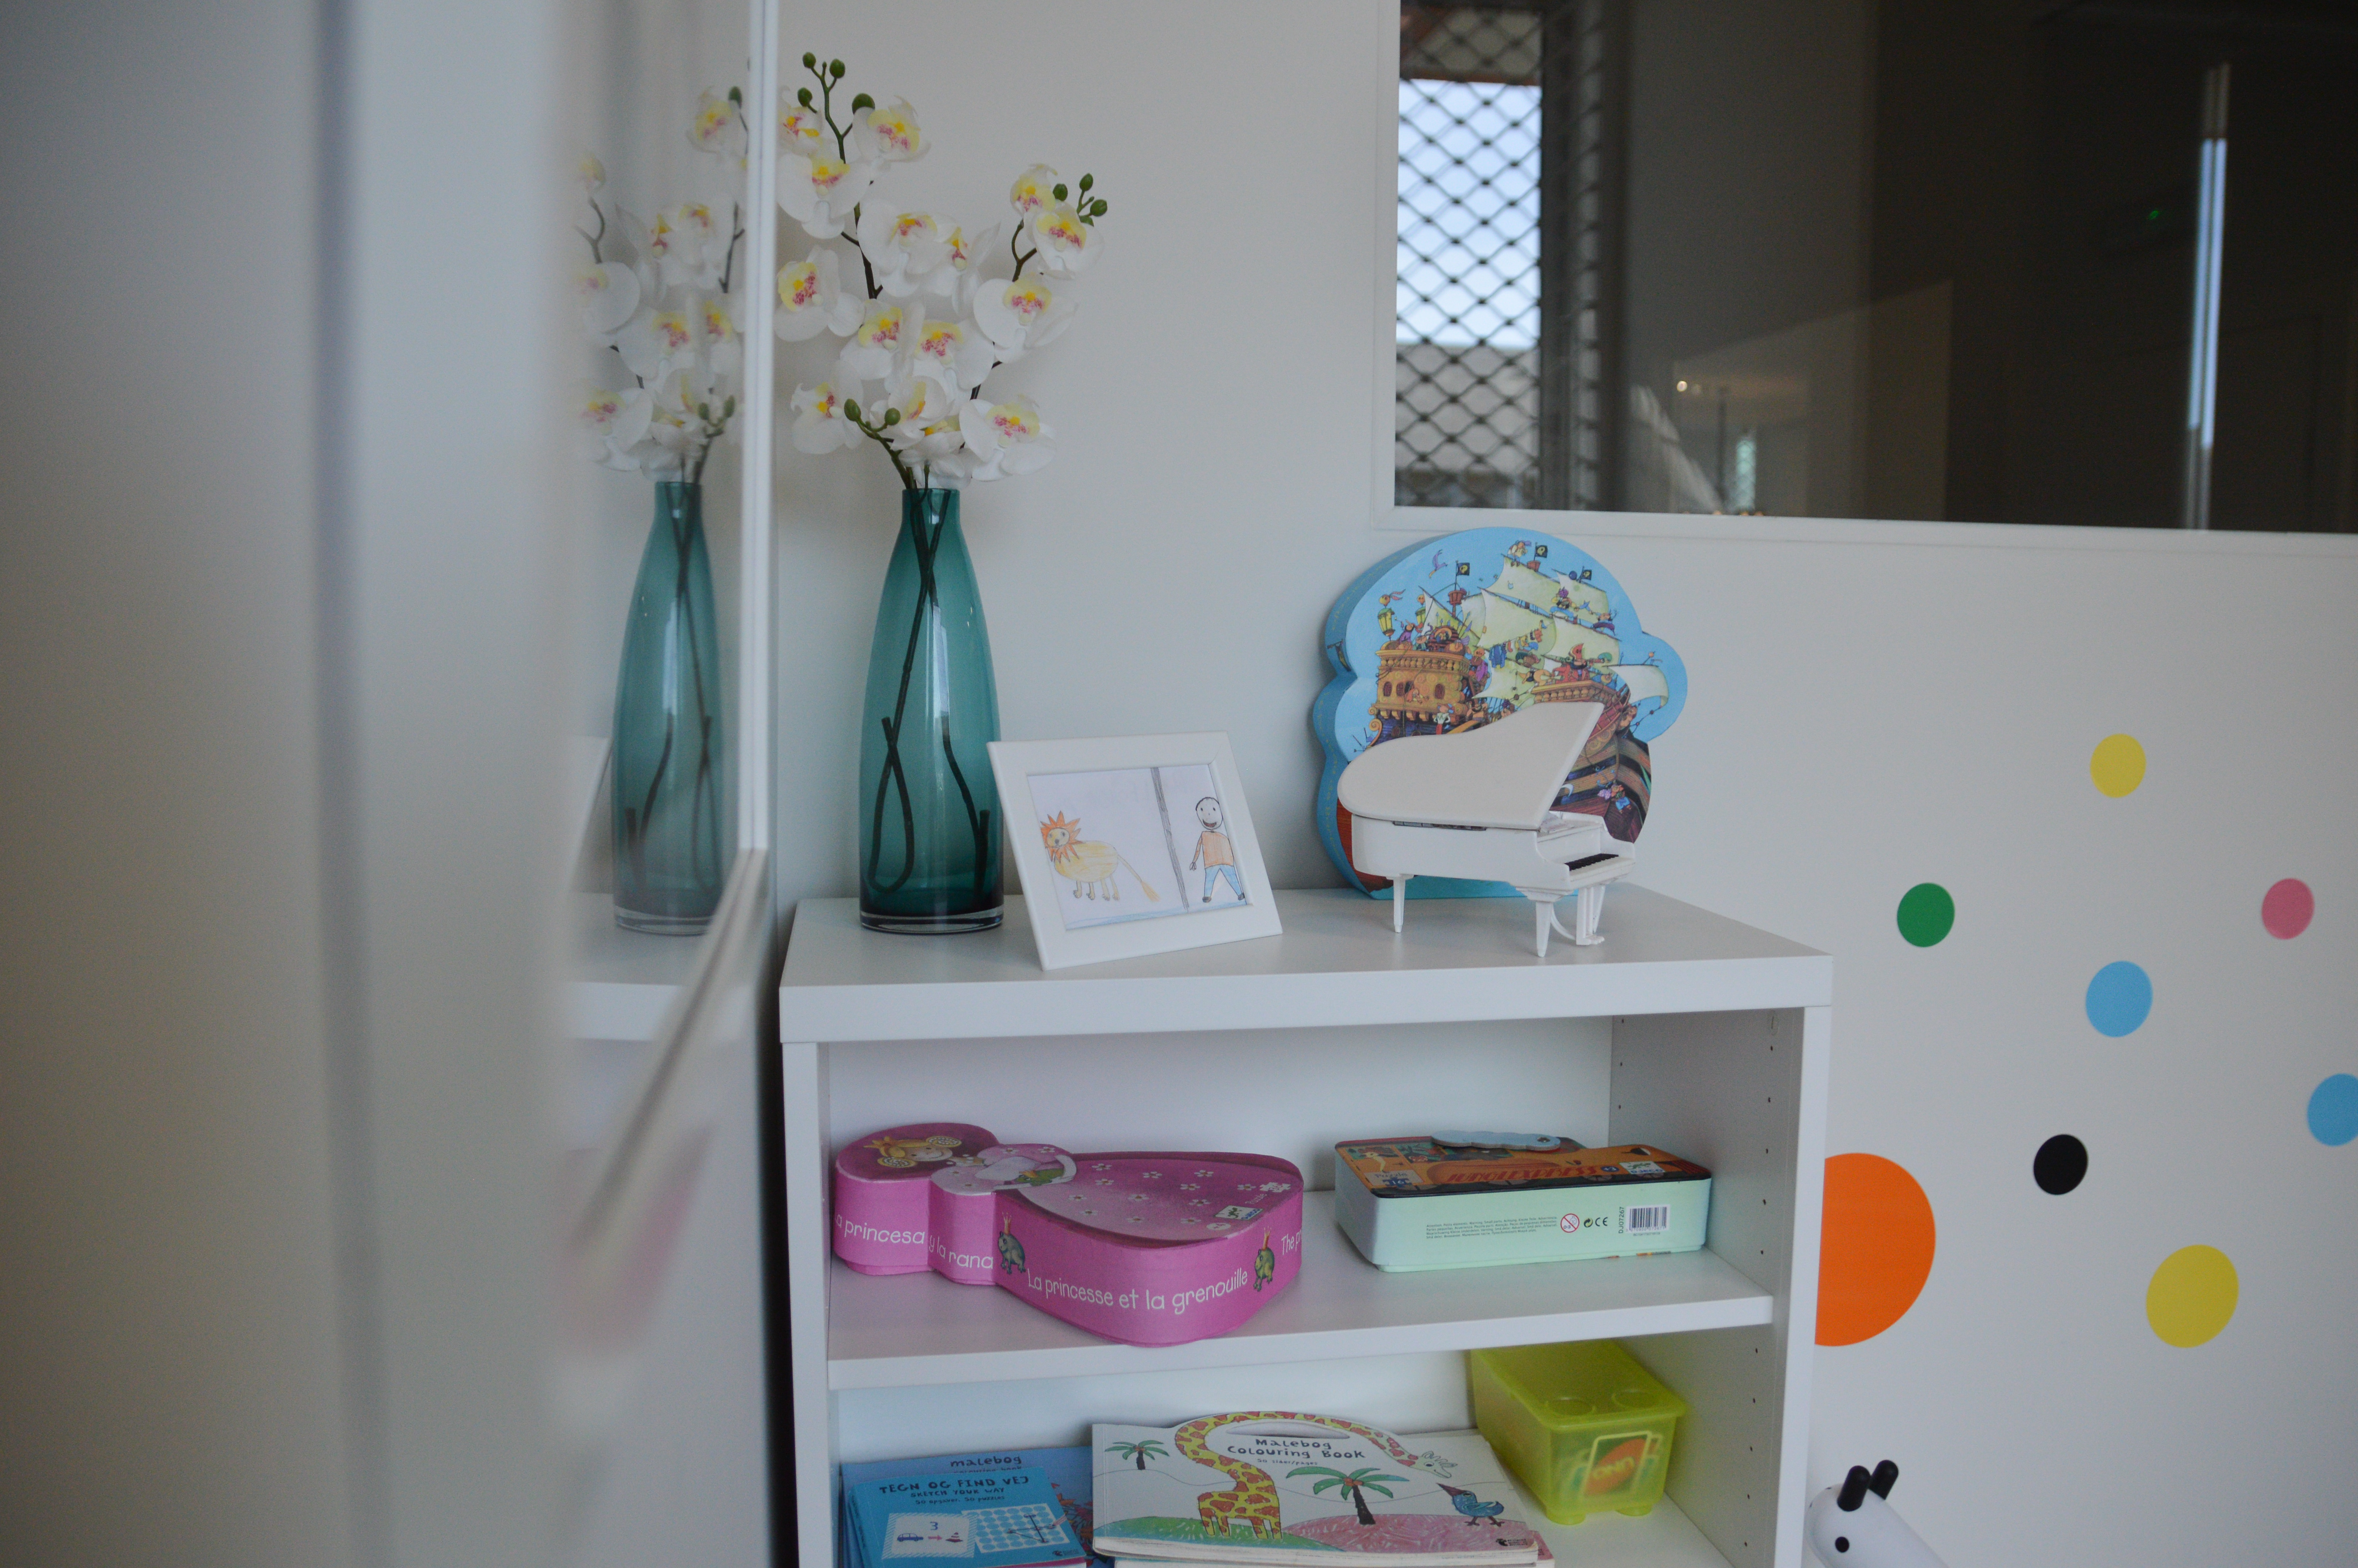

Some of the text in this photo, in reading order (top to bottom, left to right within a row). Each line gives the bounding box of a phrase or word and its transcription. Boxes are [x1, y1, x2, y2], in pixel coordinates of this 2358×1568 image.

[845, 1220, 925, 1244] princesa
[929, 1235, 935, 1252] y
[937, 1237, 946, 1259] la
[949, 1251, 993, 1270] rana
[1281, 1233, 1295, 1255] The
[1028, 1267, 1248, 1315] La princesse et la grenouille
[1256, 1439, 1331, 1449] Malebog
[1228, 1446, 1365, 1458] Colouring Book
[951, 1456, 1022, 1467] malebog
[879, 1483, 920, 1493] TEGN
[957, 1478, 996, 1487] FIND
[1002, 1476, 1029, 1485] VEJ
[930, 1521, 938, 1531] 3
